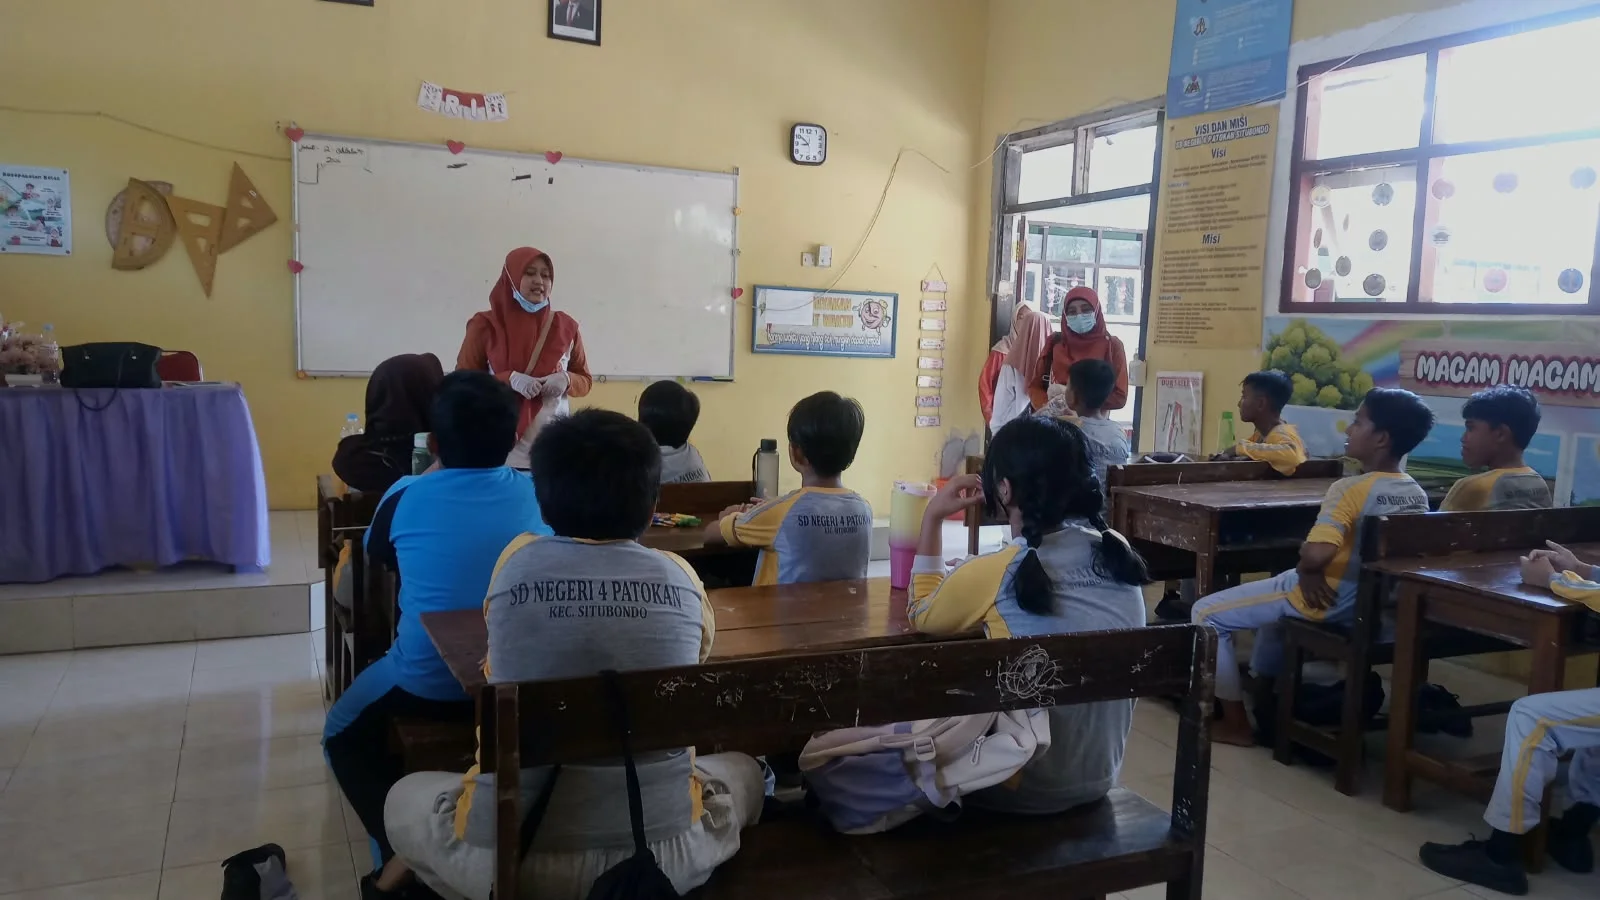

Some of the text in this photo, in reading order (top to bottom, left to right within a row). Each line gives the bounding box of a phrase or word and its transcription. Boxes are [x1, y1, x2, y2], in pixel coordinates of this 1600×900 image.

[1195, 115, 1248, 136] VISI DAN MISI
[1211, 147, 1226, 159] Visi
[1202, 234, 1221, 244] Misi
[1416, 355, 1600, 393] MACAM MACAM
[1376, 495, 1387, 505] SD
[798, 515, 809, 526] SD
[811, 514, 838, 527] NEGERI
[840, 516, 845, 526] 4
[509, 580, 682, 609] SD NEGERI 4 PATOKAN
[549, 605, 648, 619] KEC. SITUBONDO
